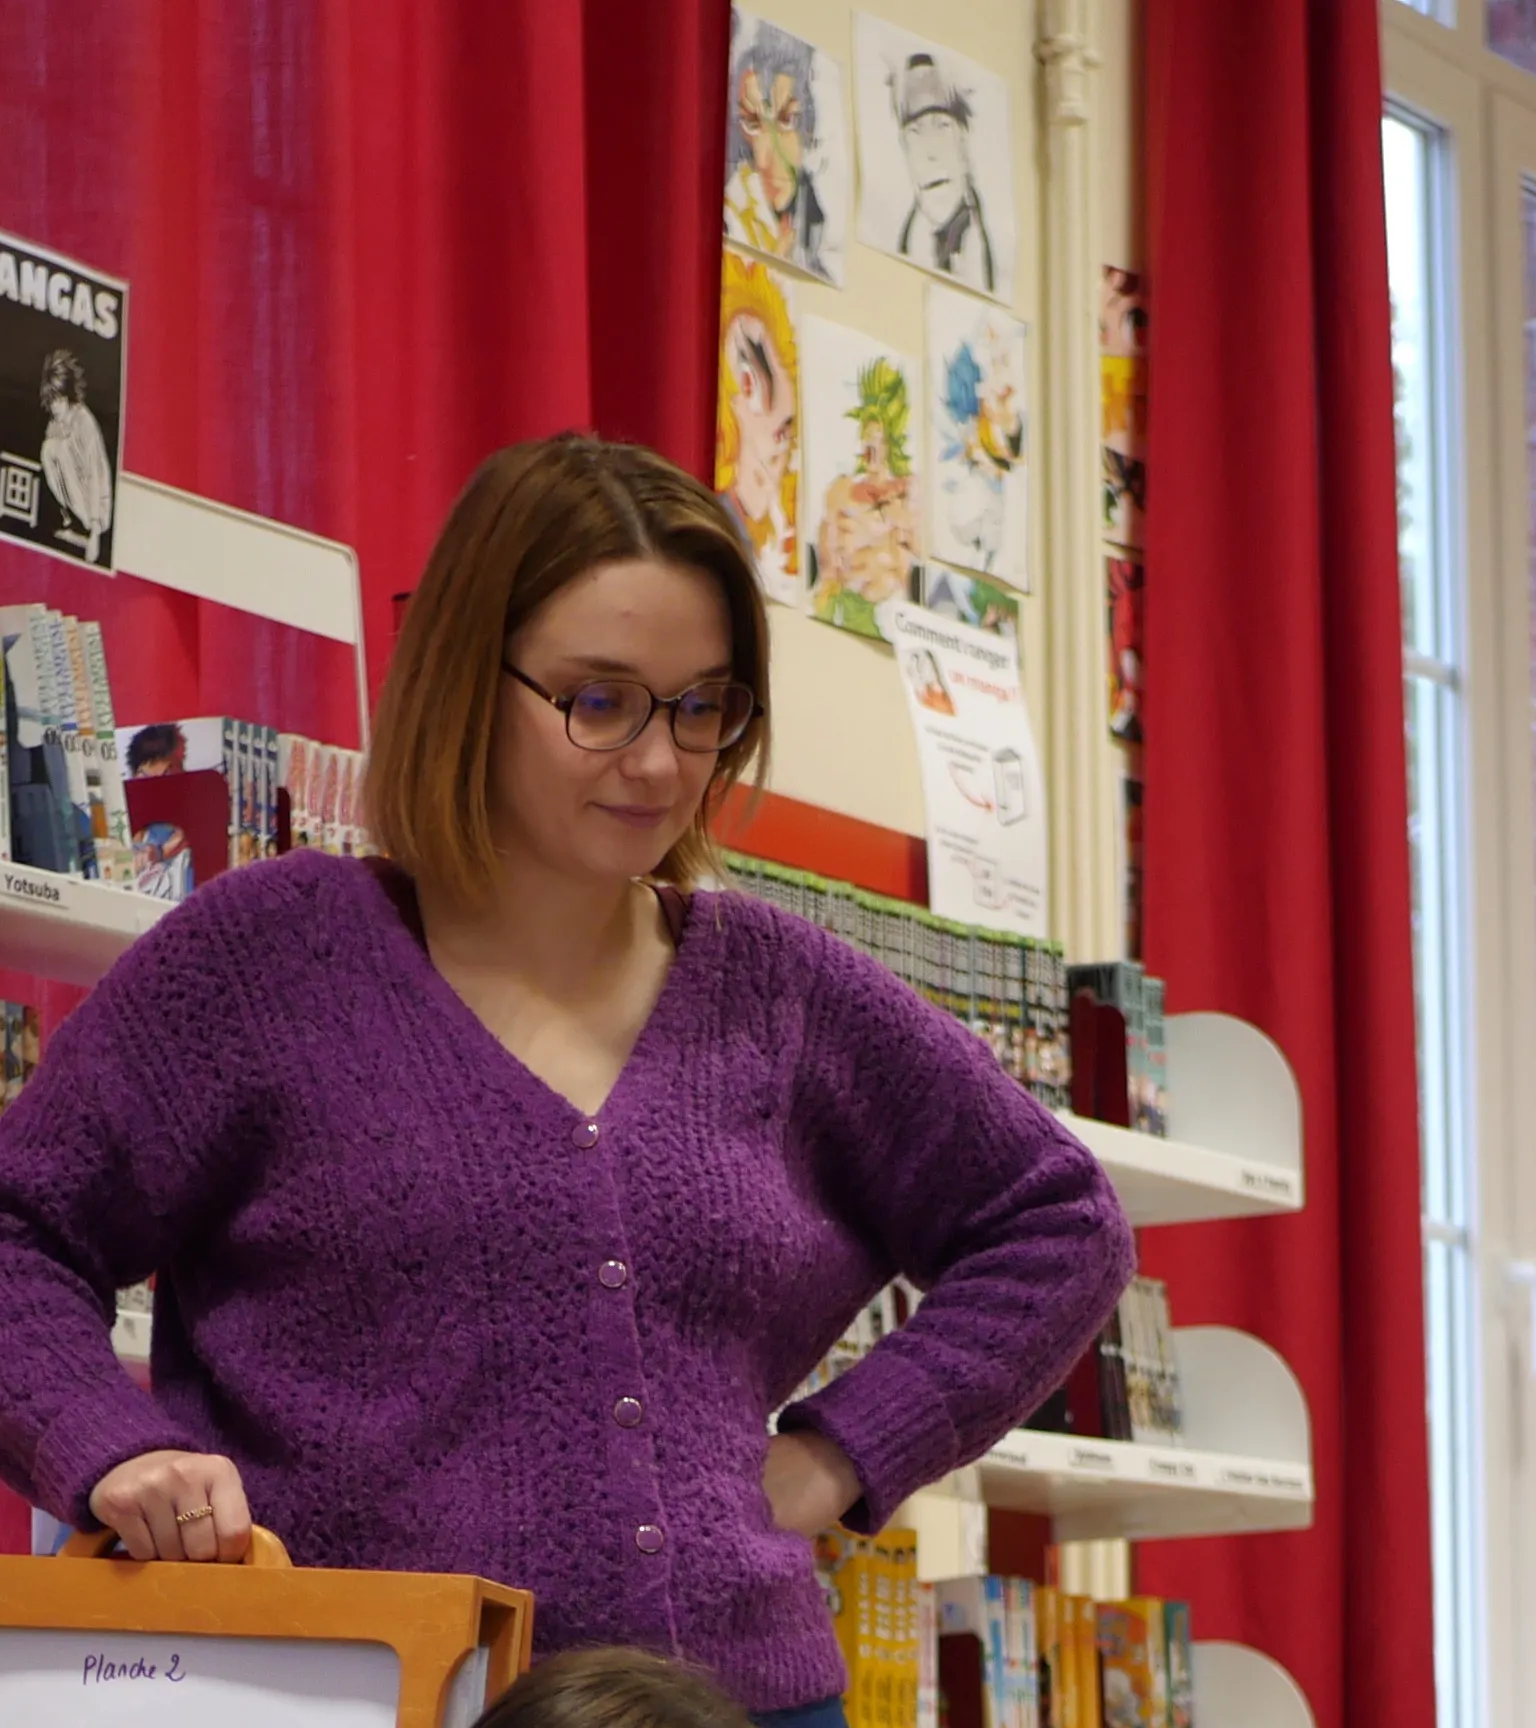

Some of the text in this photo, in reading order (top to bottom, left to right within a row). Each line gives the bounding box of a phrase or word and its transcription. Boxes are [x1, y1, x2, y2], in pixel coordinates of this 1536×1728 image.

[4, 874, 61, 901] Yotsuba
[82, 1653, 186, 1686] Planche 2
